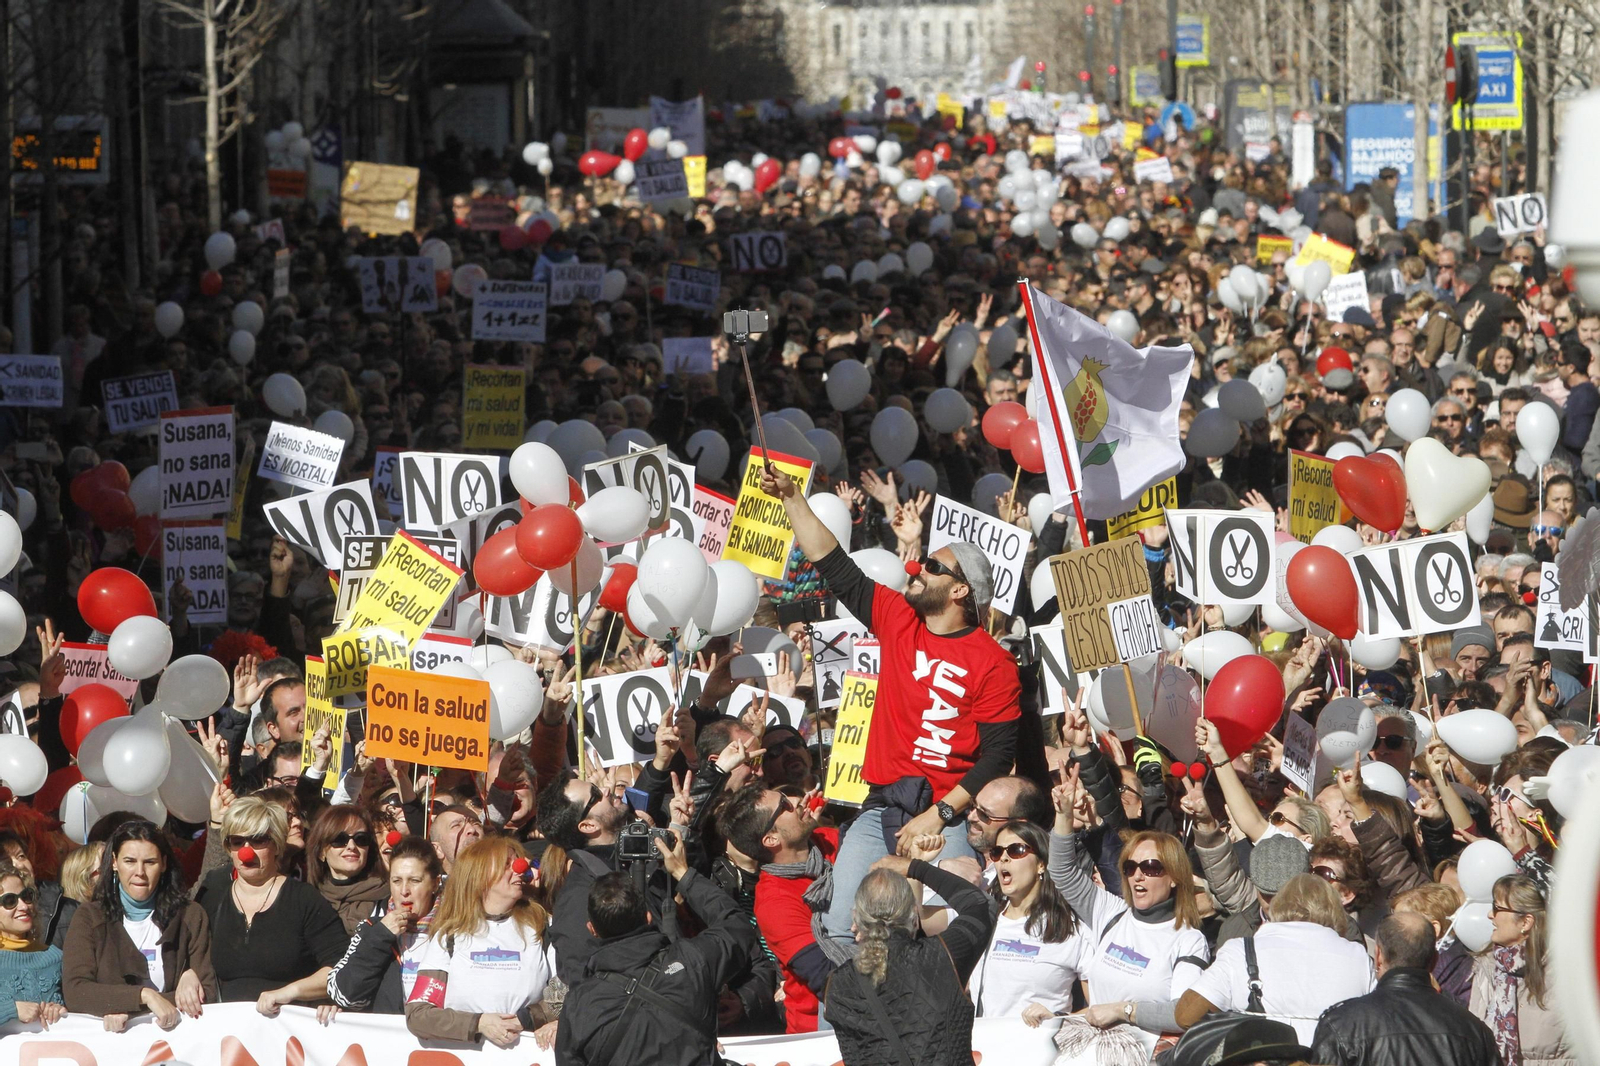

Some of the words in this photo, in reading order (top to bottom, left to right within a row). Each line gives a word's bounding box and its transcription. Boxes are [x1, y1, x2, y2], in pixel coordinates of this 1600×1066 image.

[1480, 82, 1507, 97] AXI
[1496, 197, 1543, 230] NO
[733, 235, 784, 270] NO
[105, 382, 123, 399] SE
[126, 373, 171, 394] VENDE
[111, 403, 130, 425] TU
[131, 396, 172, 421] SALUD
[485, 396, 520, 412] salud
[164, 422, 231, 444] Susana,
[268, 433, 303, 452] ¡Menos
[303, 440, 341, 463] Sanidad
[164, 457, 185, 474] no
[189, 453, 231, 471] sana
[264, 454, 280, 470] ES
[280, 458, 334, 485] MORTAL!
[1293, 459, 1334, 489] ¡Recorta
[163, 478, 231, 510] ¡NADA!
[403, 457, 497, 526] NO
[692, 500, 721, 523] ortar
[1292, 494, 1306, 517] mi
[1307, 496, 1336, 523] salud
[268, 488, 376, 567] NO
[937, 504, 1020, 561] DERECHO
[167, 532, 225, 554] Susana,
[347, 541, 374, 568] SE
[699, 531, 721, 556] ción
[728, 525, 745, 549] EN
[742, 530, 785, 564] SANIDAD.
[1166, 515, 1270, 600] NO
[167, 565, 186, 582] no
[190, 564, 225, 581] sana
[382, 543, 451, 595] ¡Recortan
[1050, 552, 1103, 611] TODOS
[1095, 540, 1149, 600] SOMOS
[366, 578, 393, 600] mi
[385, 590, 435, 627] salud
[1354, 540, 1475, 636] NO
[1111, 598, 1162, 661] CANDEL
[1562, 615, 1584, 641] CRI
[328, 675, 347, 691] TU
[371, 683, 408, 711] Con
[414, 689, 430, 714] la
[434, 695, 488, 723] salud
[369, 723, 394, 743] no
[398, 727, 420, 748] se
[422, 726, 484, 761] juega.
[837, 721, 866, 746] mi
[831, 761, 847, 788] y
